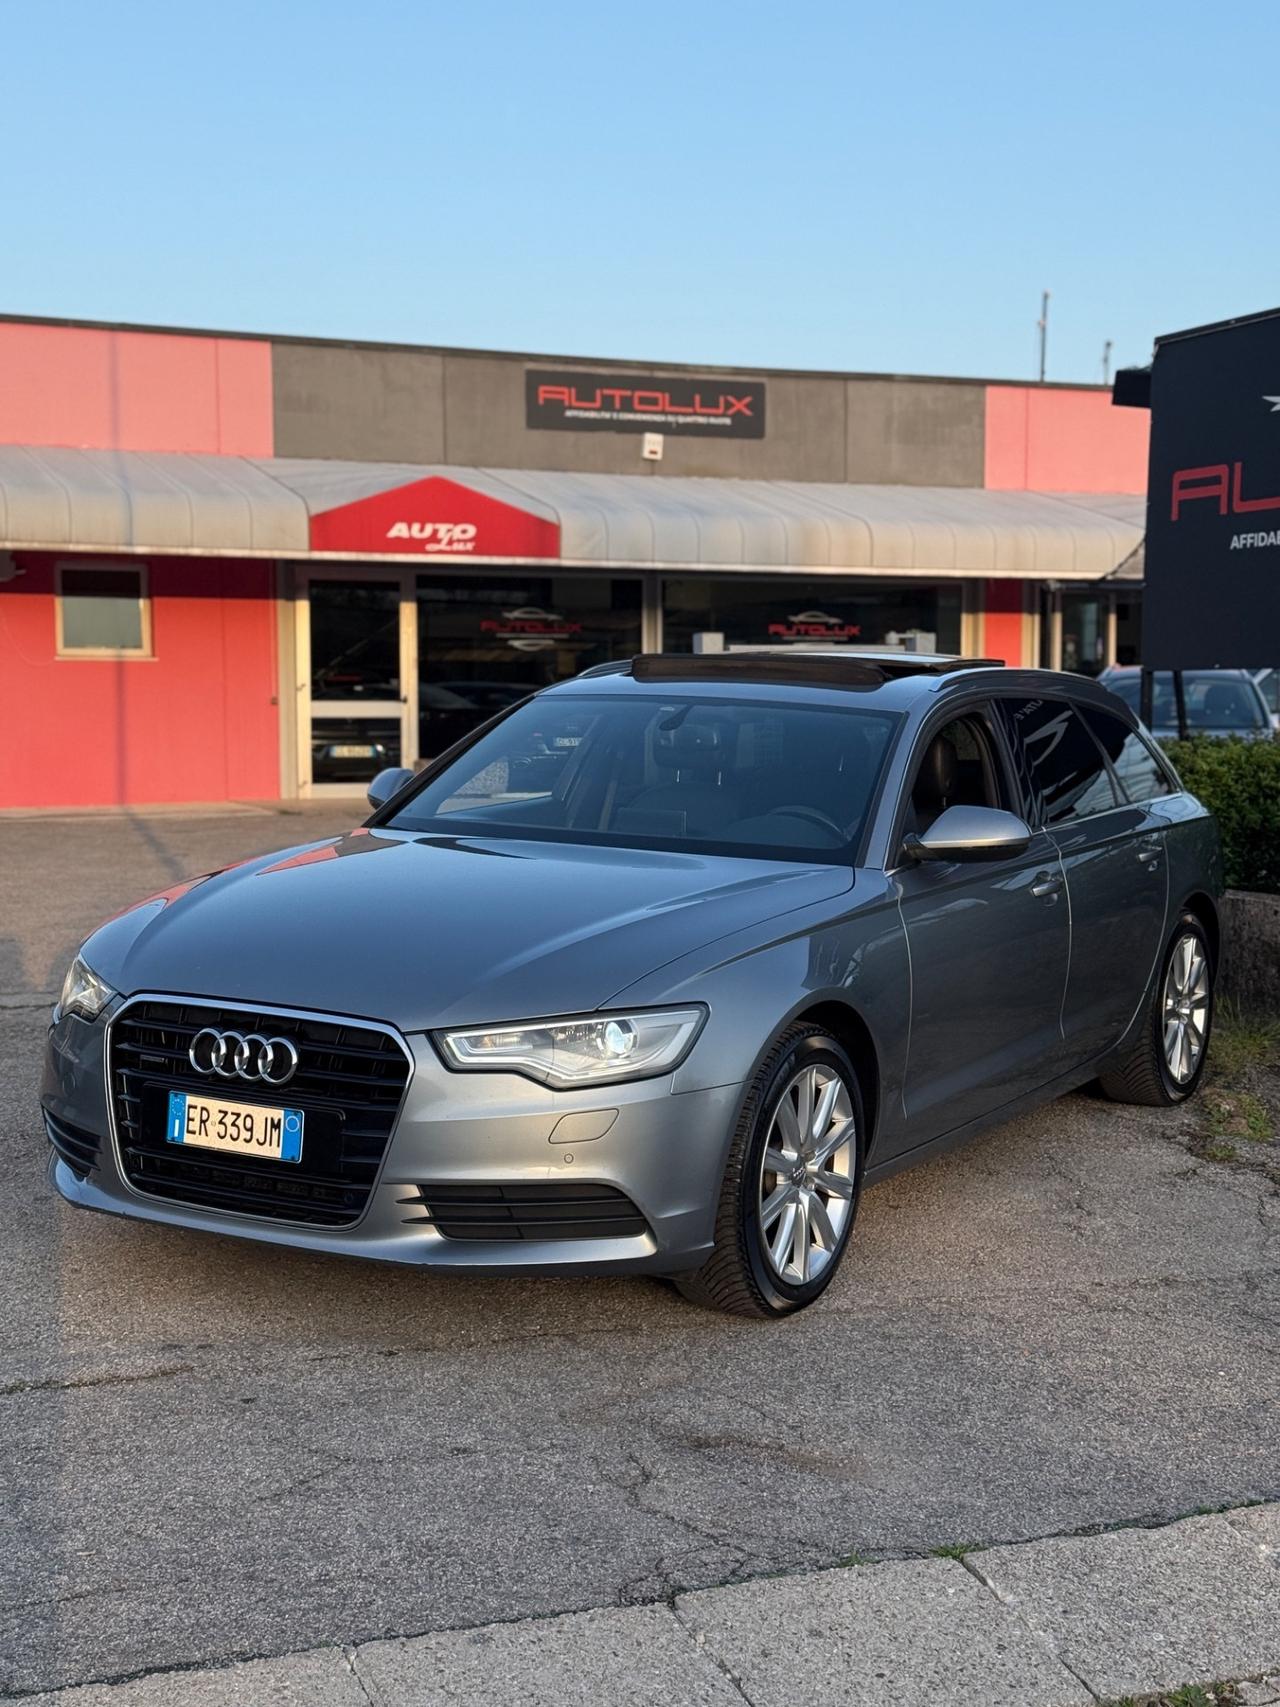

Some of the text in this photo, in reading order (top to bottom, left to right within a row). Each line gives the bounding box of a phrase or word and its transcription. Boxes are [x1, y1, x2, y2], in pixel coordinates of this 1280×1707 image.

[538, 385, 753, 417] AUTOLUX
[386, 521, 477, 541] AUTO
[768, 623, 862, 636] AUTOLUX
[186, 1103, 282, 1148] ER 339JM
